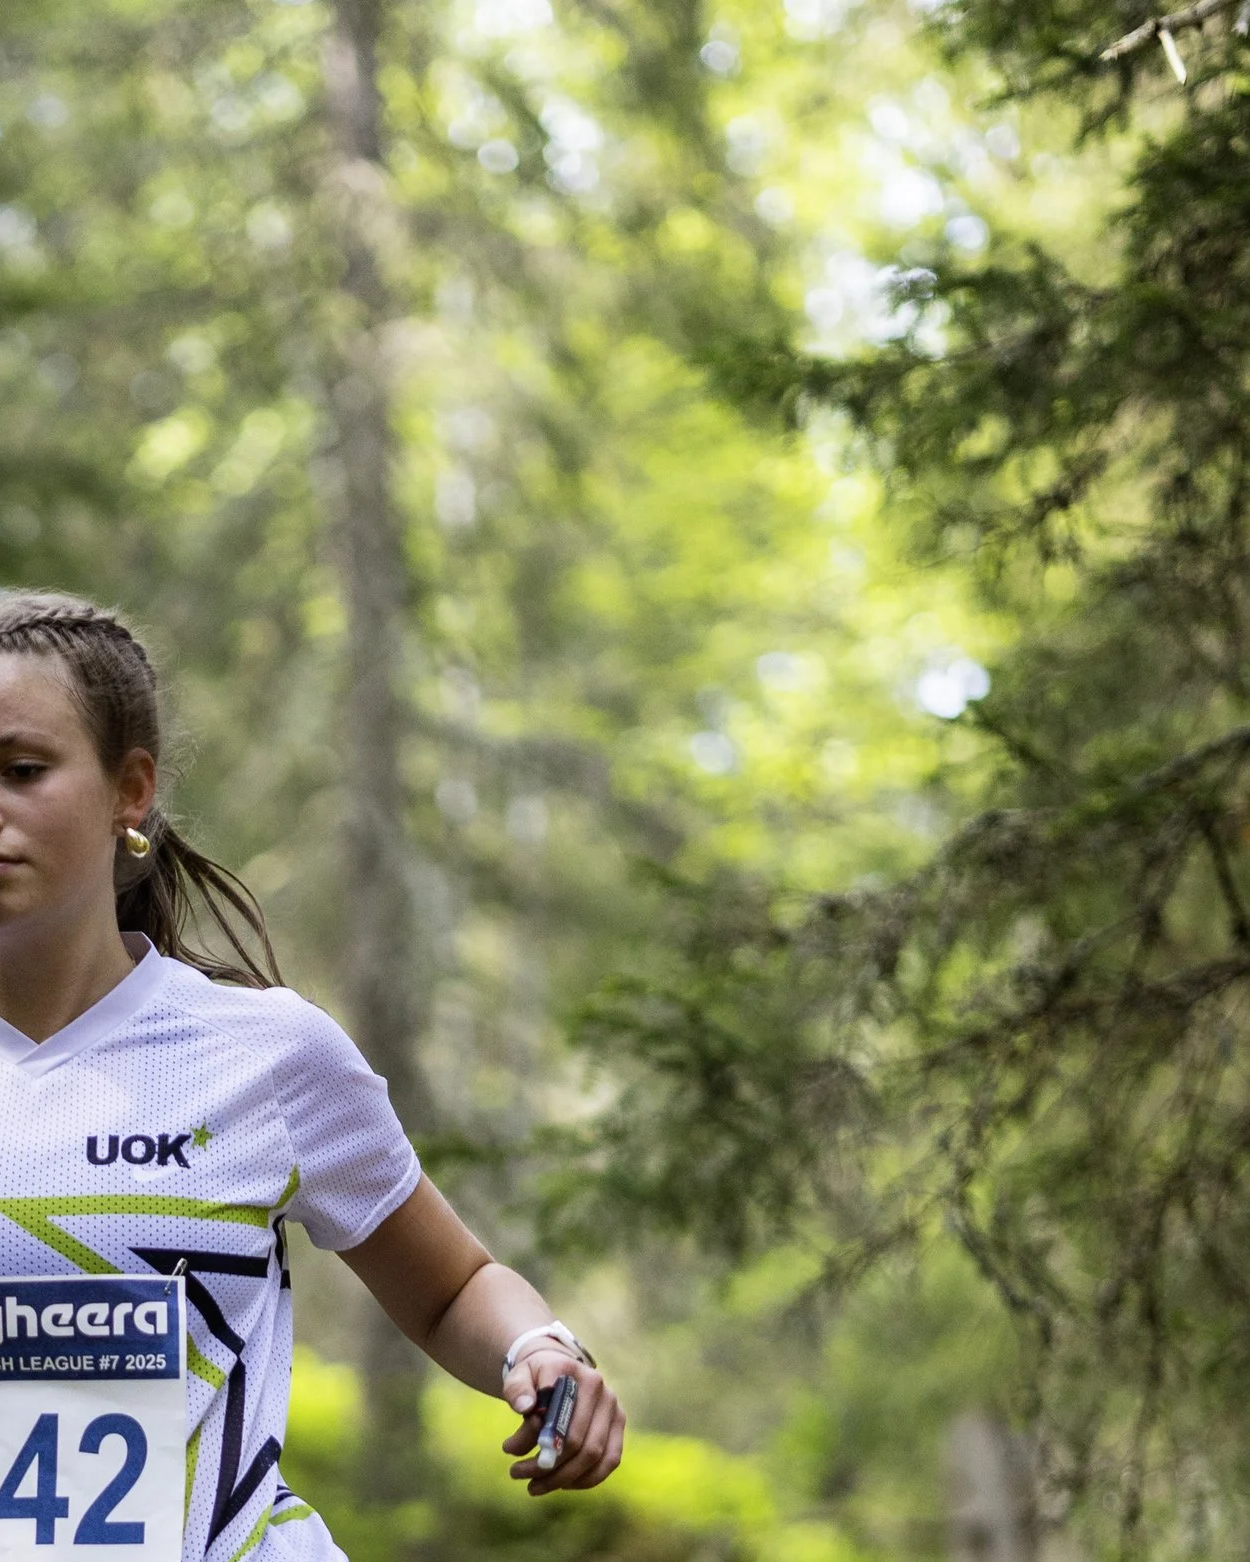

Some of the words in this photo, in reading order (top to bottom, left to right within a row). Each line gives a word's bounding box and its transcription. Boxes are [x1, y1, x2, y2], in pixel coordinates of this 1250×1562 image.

[86, 1132, 192, 1168] UOK
[19, 1355, 95, 1371] LEAGUE
[99, 1355, 119, 1370] #7
[125, 1354, 167, 1370] 2025
